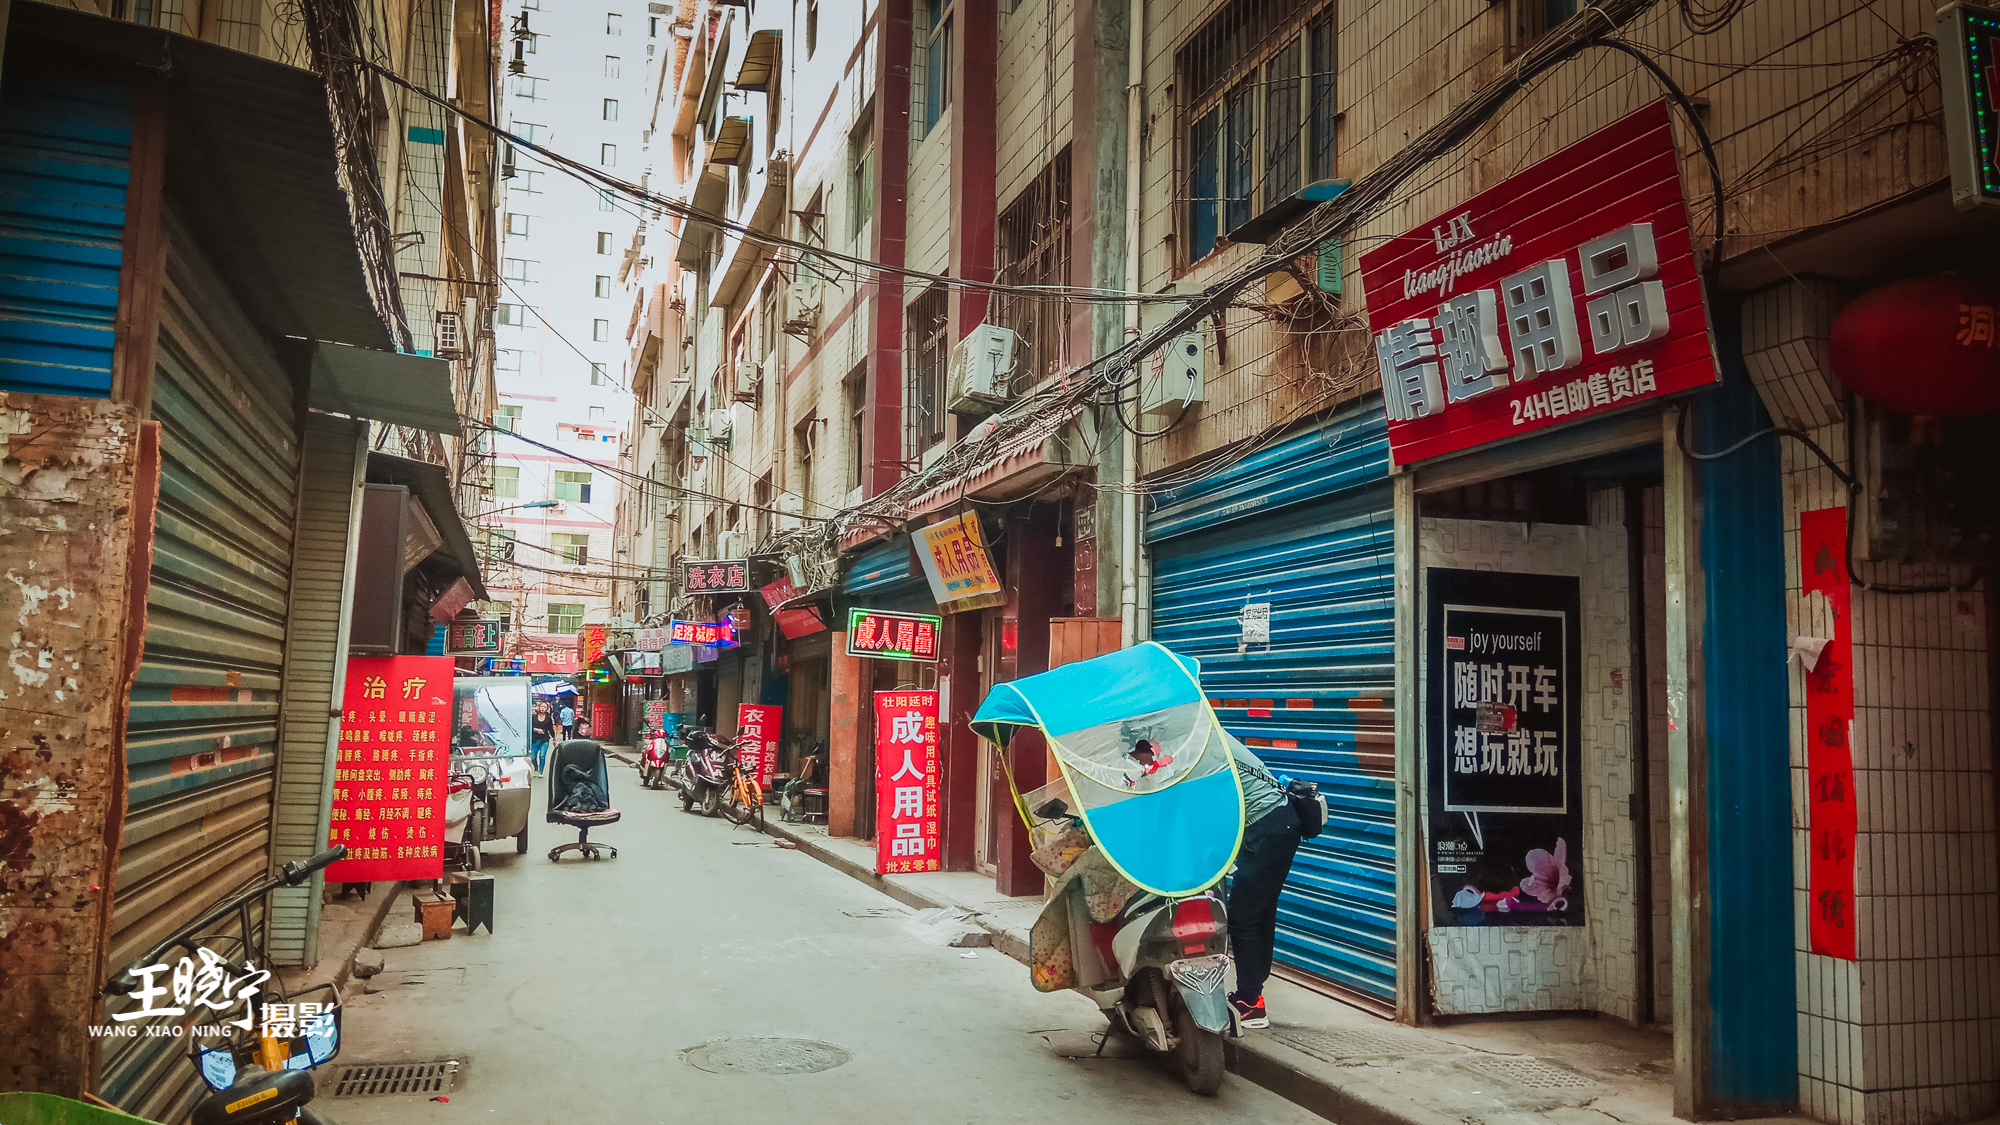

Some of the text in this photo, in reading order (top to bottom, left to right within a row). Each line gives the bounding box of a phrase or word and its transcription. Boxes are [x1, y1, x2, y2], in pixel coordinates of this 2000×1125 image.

[1432, 211, 1475, 254] LJX
[1403, 233, 1513, 300] liangjiaoxin
[1375, 222, 1670, 421] 情趣用品
[1509, 360, 1657, 425] 24H自助售货店
[688, 565, 744, 589] 洗衣店
[934, 537, 981, 579] 成人用品
[452, 624, 496, 648] 高高在上
[855, 617, 932, 653] 成人用品
[1470, 628, 1488, 653] joy
[1492, 631, 1542, 652] yourself
[363, 676, 427, 700] 治疗
[882, 695, 934, 708] 壮阳延时
[1454, 661, 1558, 713] 随时开车
[761, 741, 776, 785] 修改衣服
[1454, 725, 1558, 776] 想玩就玩
[889, 711, 925, 857] 成人用品
[341, 845, 438, 860] 肚疼及抽筋、各种皮肤病
[886, 861, 938, 873] 批发零售
